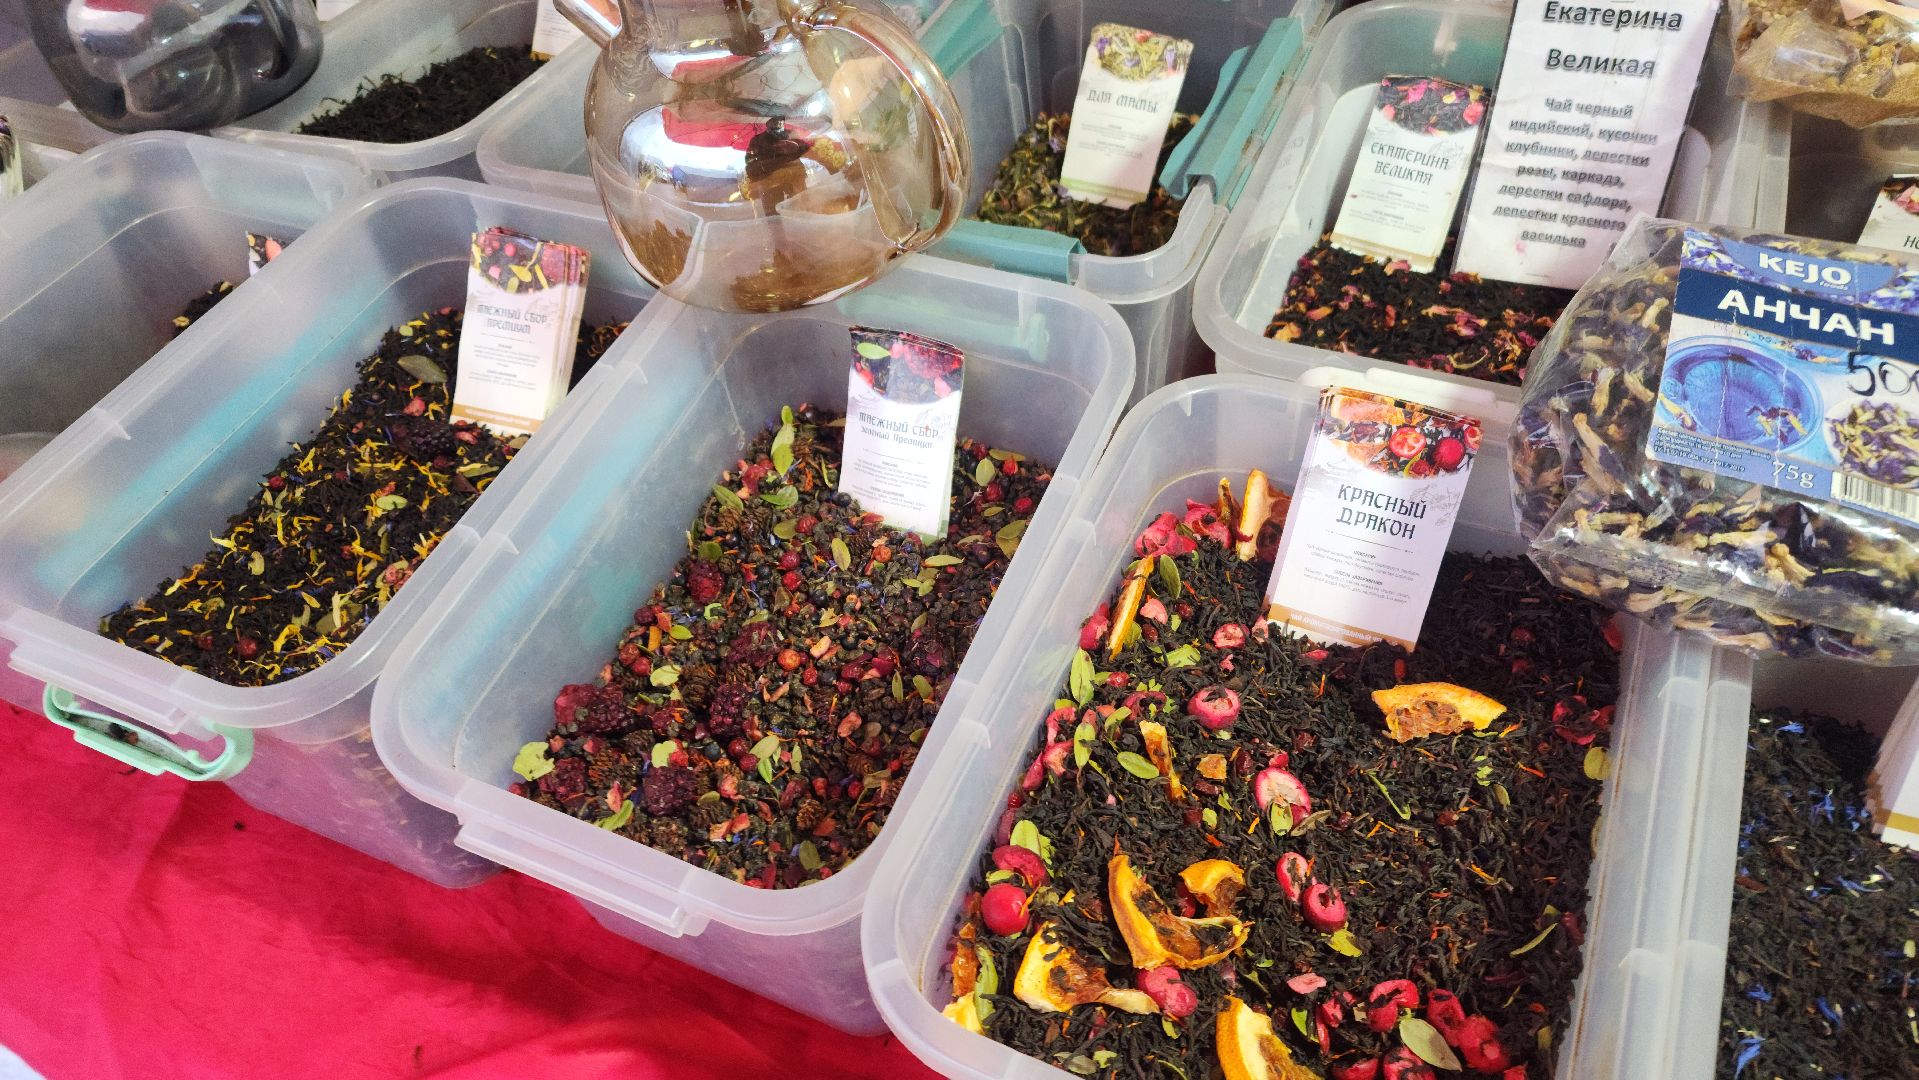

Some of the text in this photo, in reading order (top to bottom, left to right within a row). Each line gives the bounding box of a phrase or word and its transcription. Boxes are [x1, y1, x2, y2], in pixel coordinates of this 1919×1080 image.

[1544, 1, 1683, 31] Екатерина
[1546, 49, 1656, 77] Великая
[1545, 98, 1633, 118] Чай черный
[1510, 120, 1658, 145] индийский, кусочки
[1370, 142, 1449, 170] ЕКАТЕРИНА
[1505, 142, 1650, 167] клубники, лепестки
[1375, 161, 1433, 185] ВЕЛИКАЯ
[1517, 165, 1557, 180] розы,
[1567, 192, 1632, 212] сафлора,
[1493, 205, 1626, 231] лепестки красного
[1521, 230, 1586, 248] василька
[1760, 252, 1851, 285] KEJO
[1718, 289, 1895, 345] АНЧАН
[1772, 461, 1814, 489] 75g
[1337, 484, 1427, 519] КРАСНЫЙ
[1336, 507, 1416, 540] ДРАКОН
